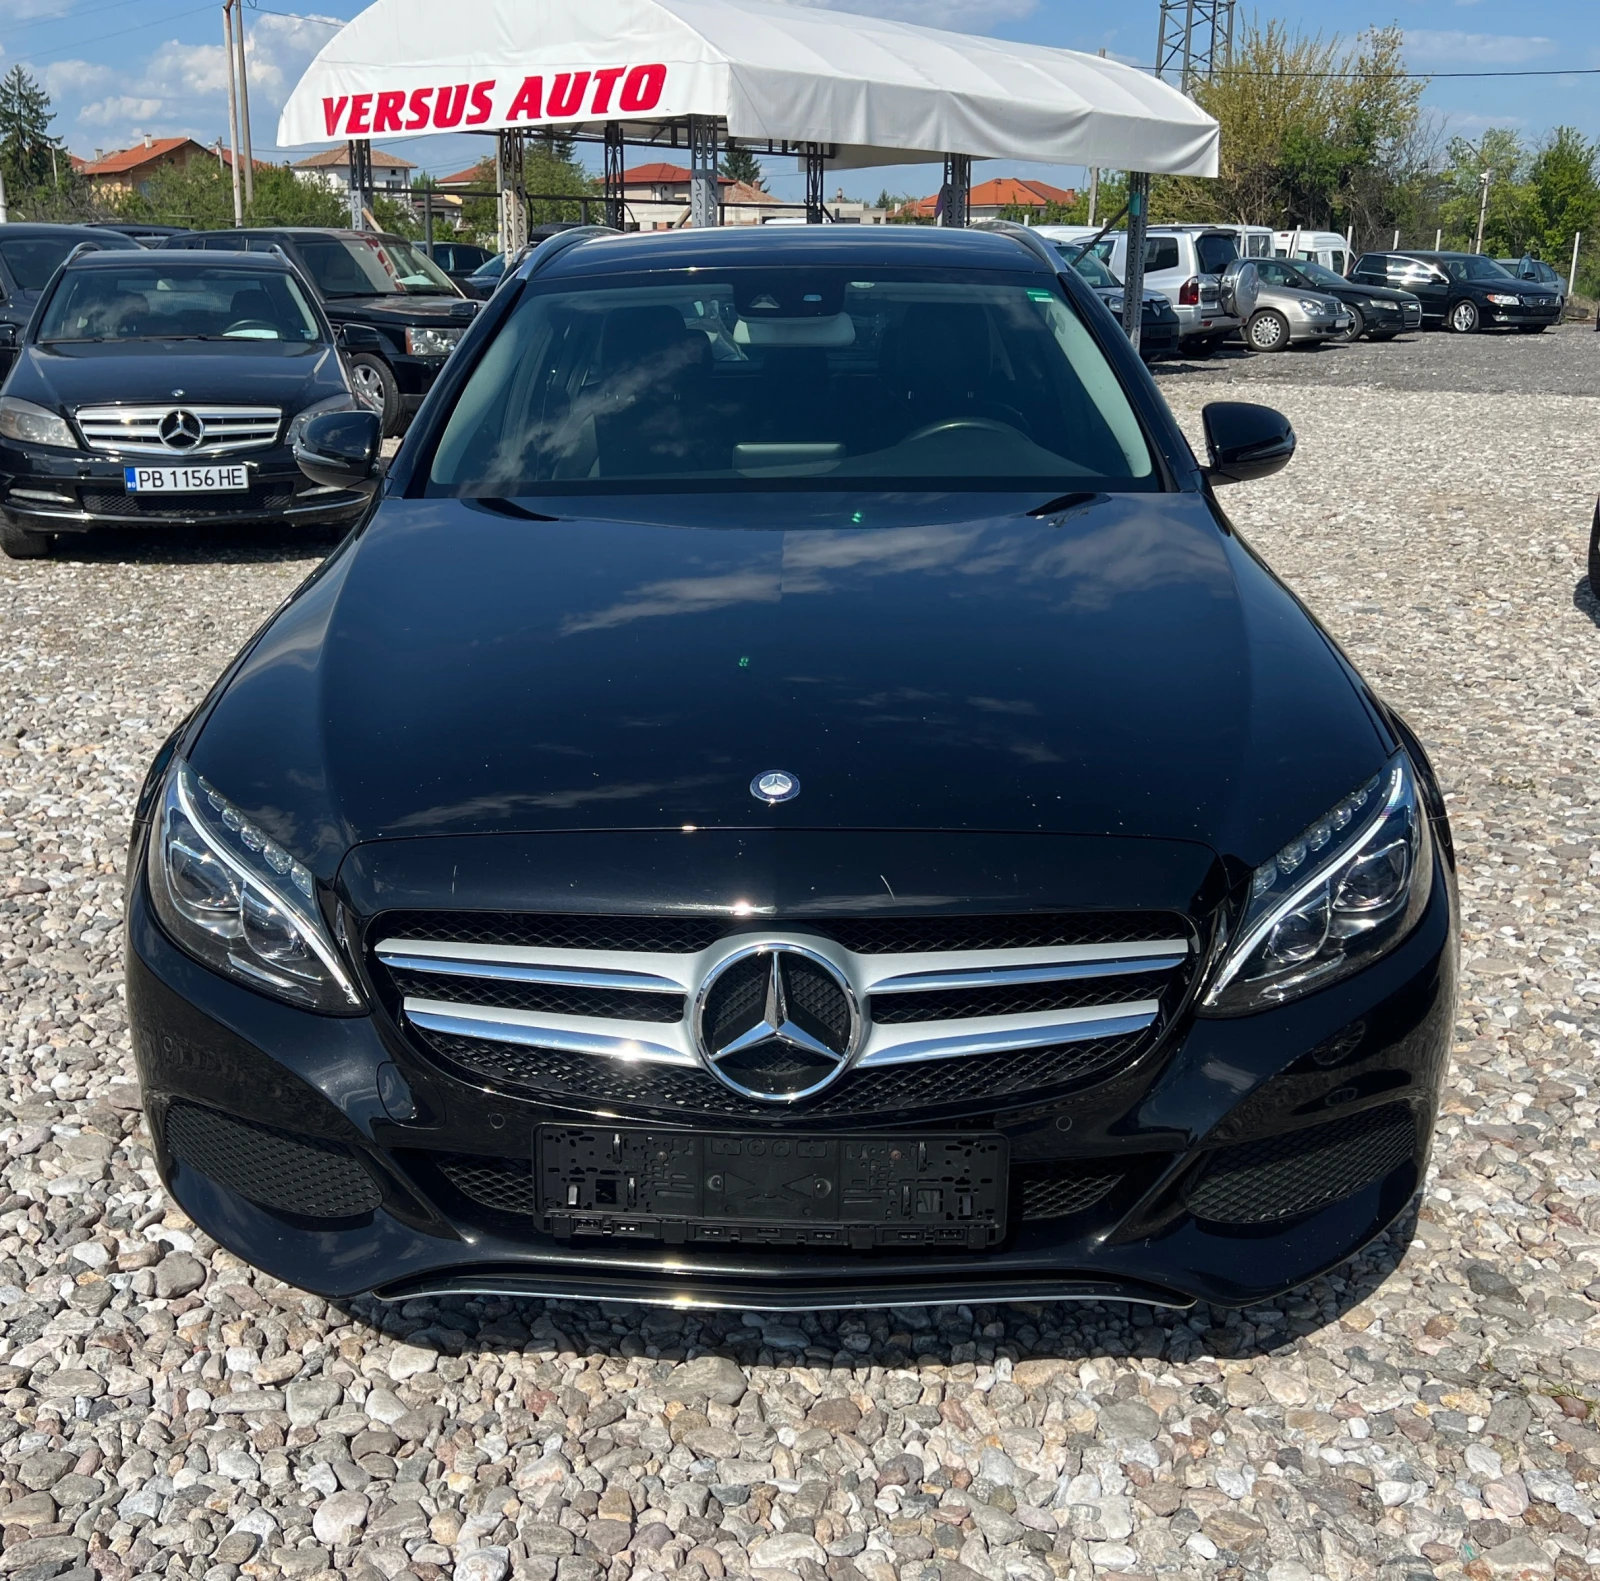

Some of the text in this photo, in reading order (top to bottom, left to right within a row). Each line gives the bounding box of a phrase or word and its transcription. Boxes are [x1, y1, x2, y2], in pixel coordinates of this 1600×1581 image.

[322, 63, 668, 137] VERSUS AUTO
[138, 468, 244, 488] PB 1156 HE
